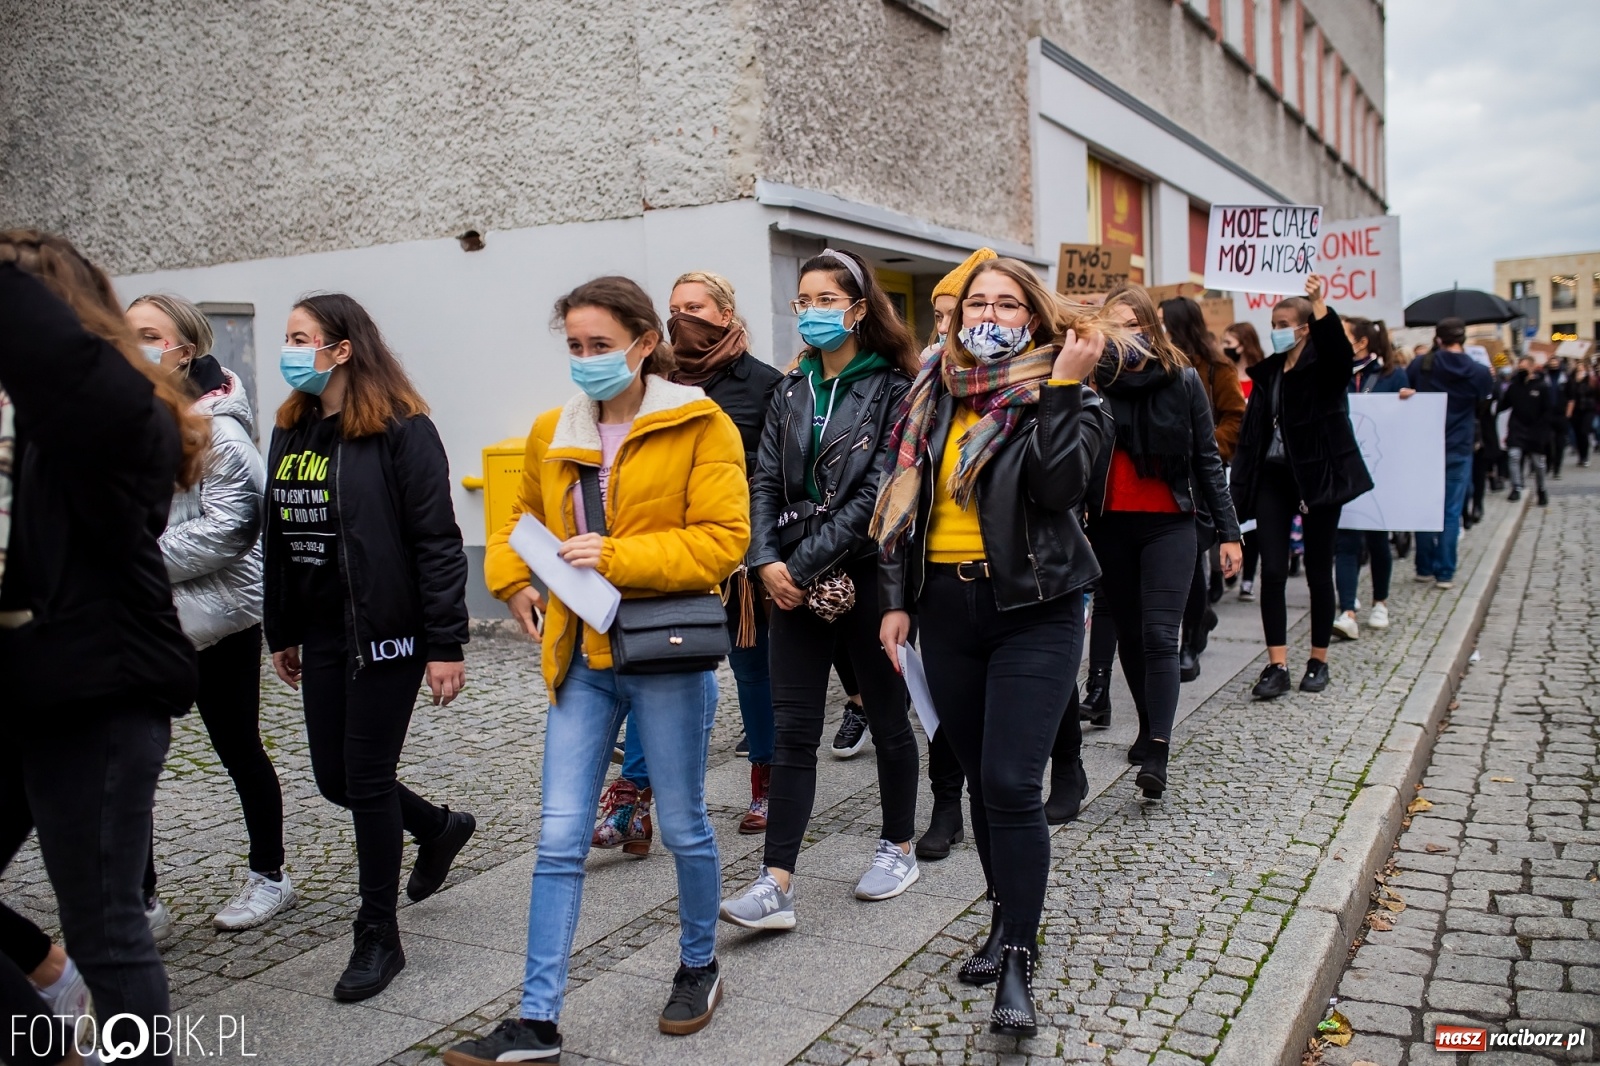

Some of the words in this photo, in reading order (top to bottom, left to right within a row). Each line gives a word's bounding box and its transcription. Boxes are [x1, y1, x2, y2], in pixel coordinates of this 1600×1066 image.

[1221, 208, 1268, 238] MOJE
[1272, 208, 1319, 239] CIAŁO
[1317, 226, 1381, 262] ONIE
[1065, 246, 1112, 270] TWÓJ
[1218, 240, 1256, 276] MÓJ
[1261, 242, 1316, 274] WYBÓR
[1066, 268, 1096, 289] BÓL
[294, 508, 308, 522] RID
[308, 508, 319, 523] OF
[319, 507, 327, 521] IT
[370, 636, 415, 661] LOW
